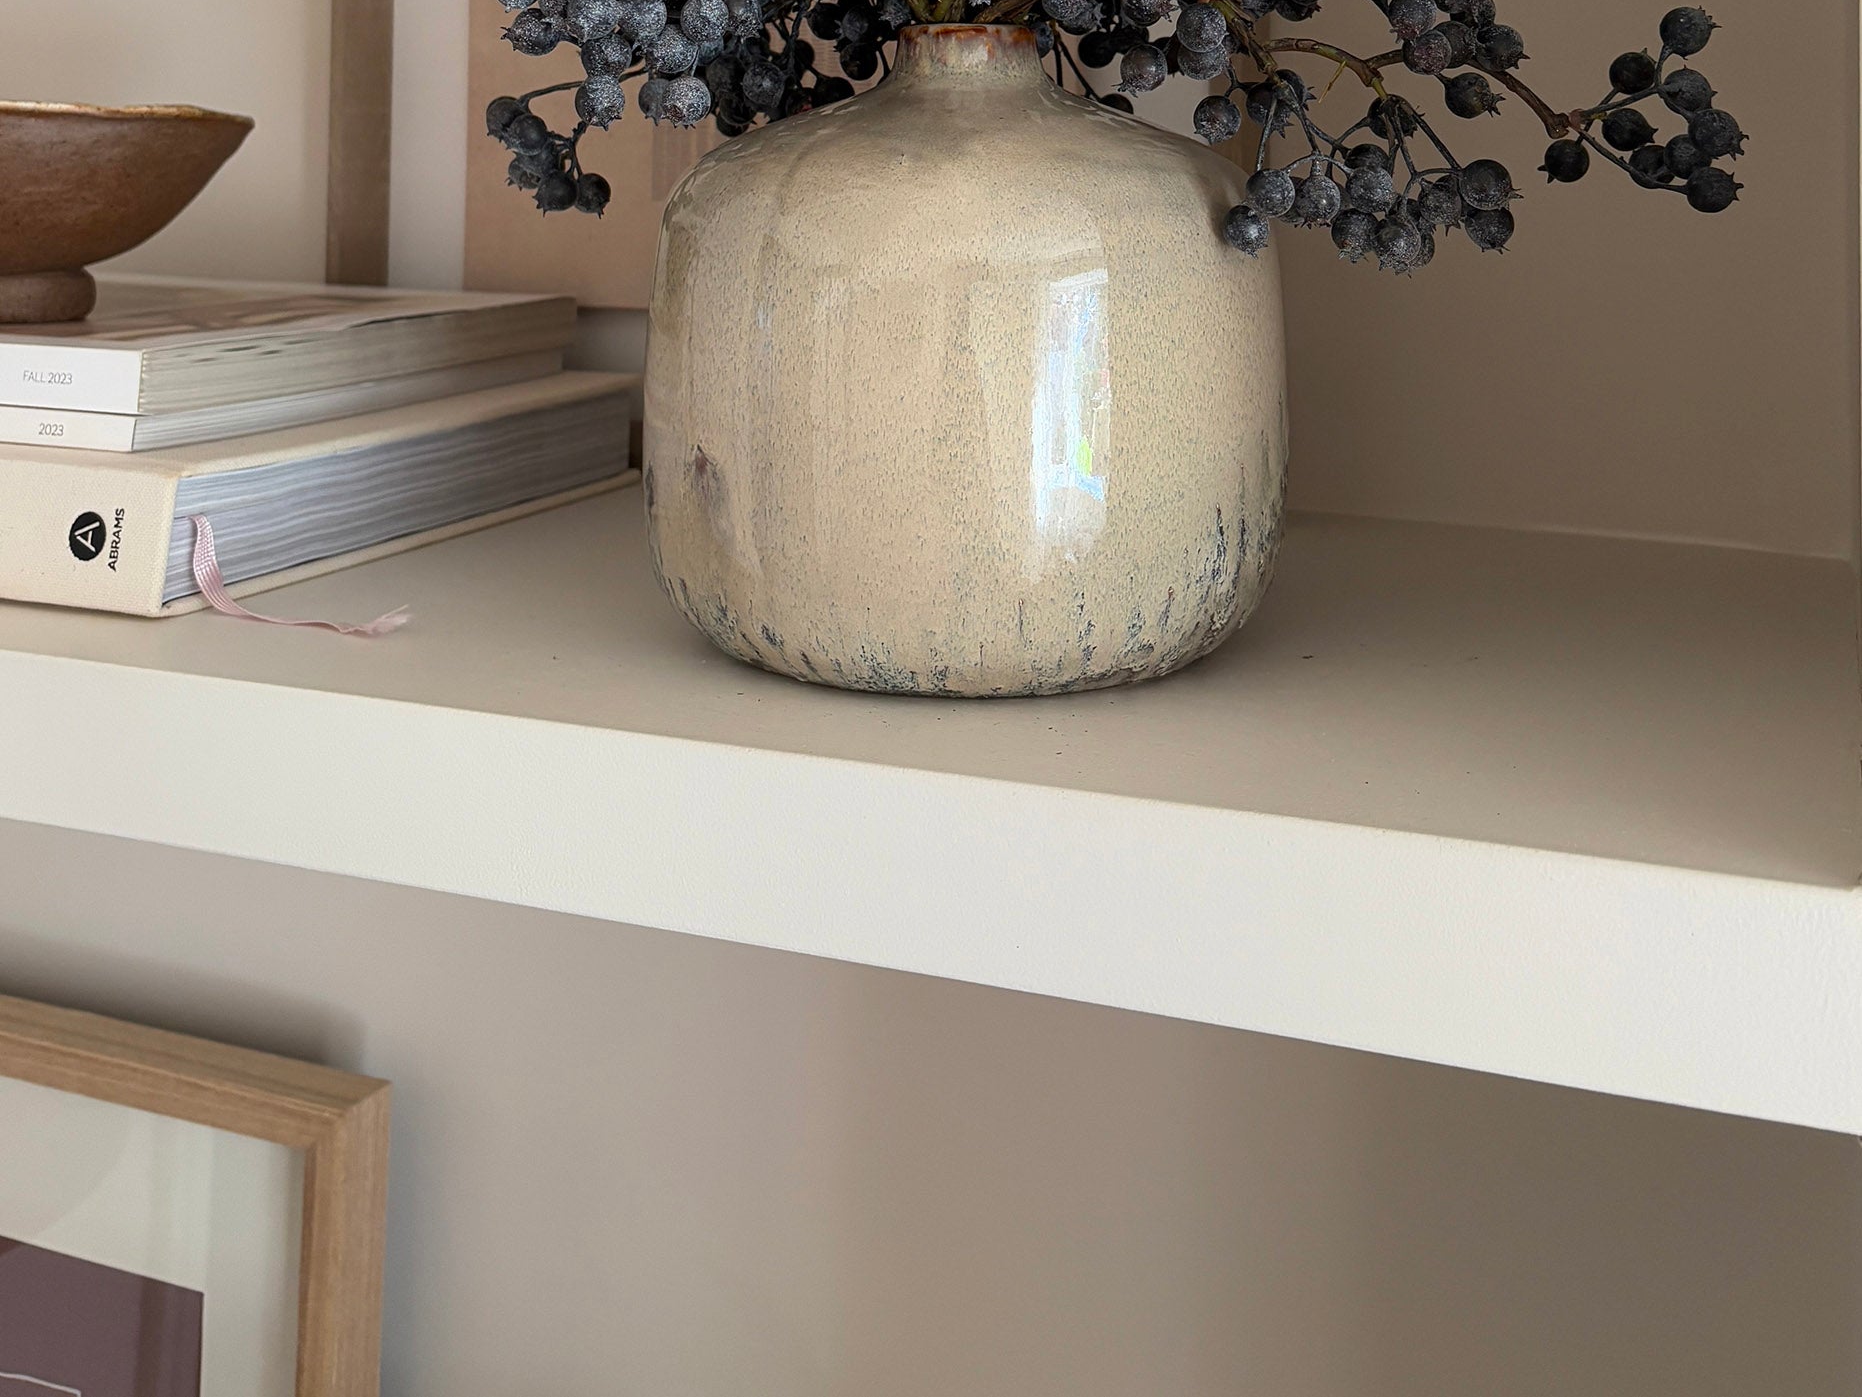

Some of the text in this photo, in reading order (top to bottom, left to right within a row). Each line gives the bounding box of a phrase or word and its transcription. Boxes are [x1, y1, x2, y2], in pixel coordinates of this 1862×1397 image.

[23, 370, 73, 385] FALL 2023
[38, 422, 65, 437] 2023
[74, 521, 100, 553] A
[107, 508, 125, 572] ABRAMS
